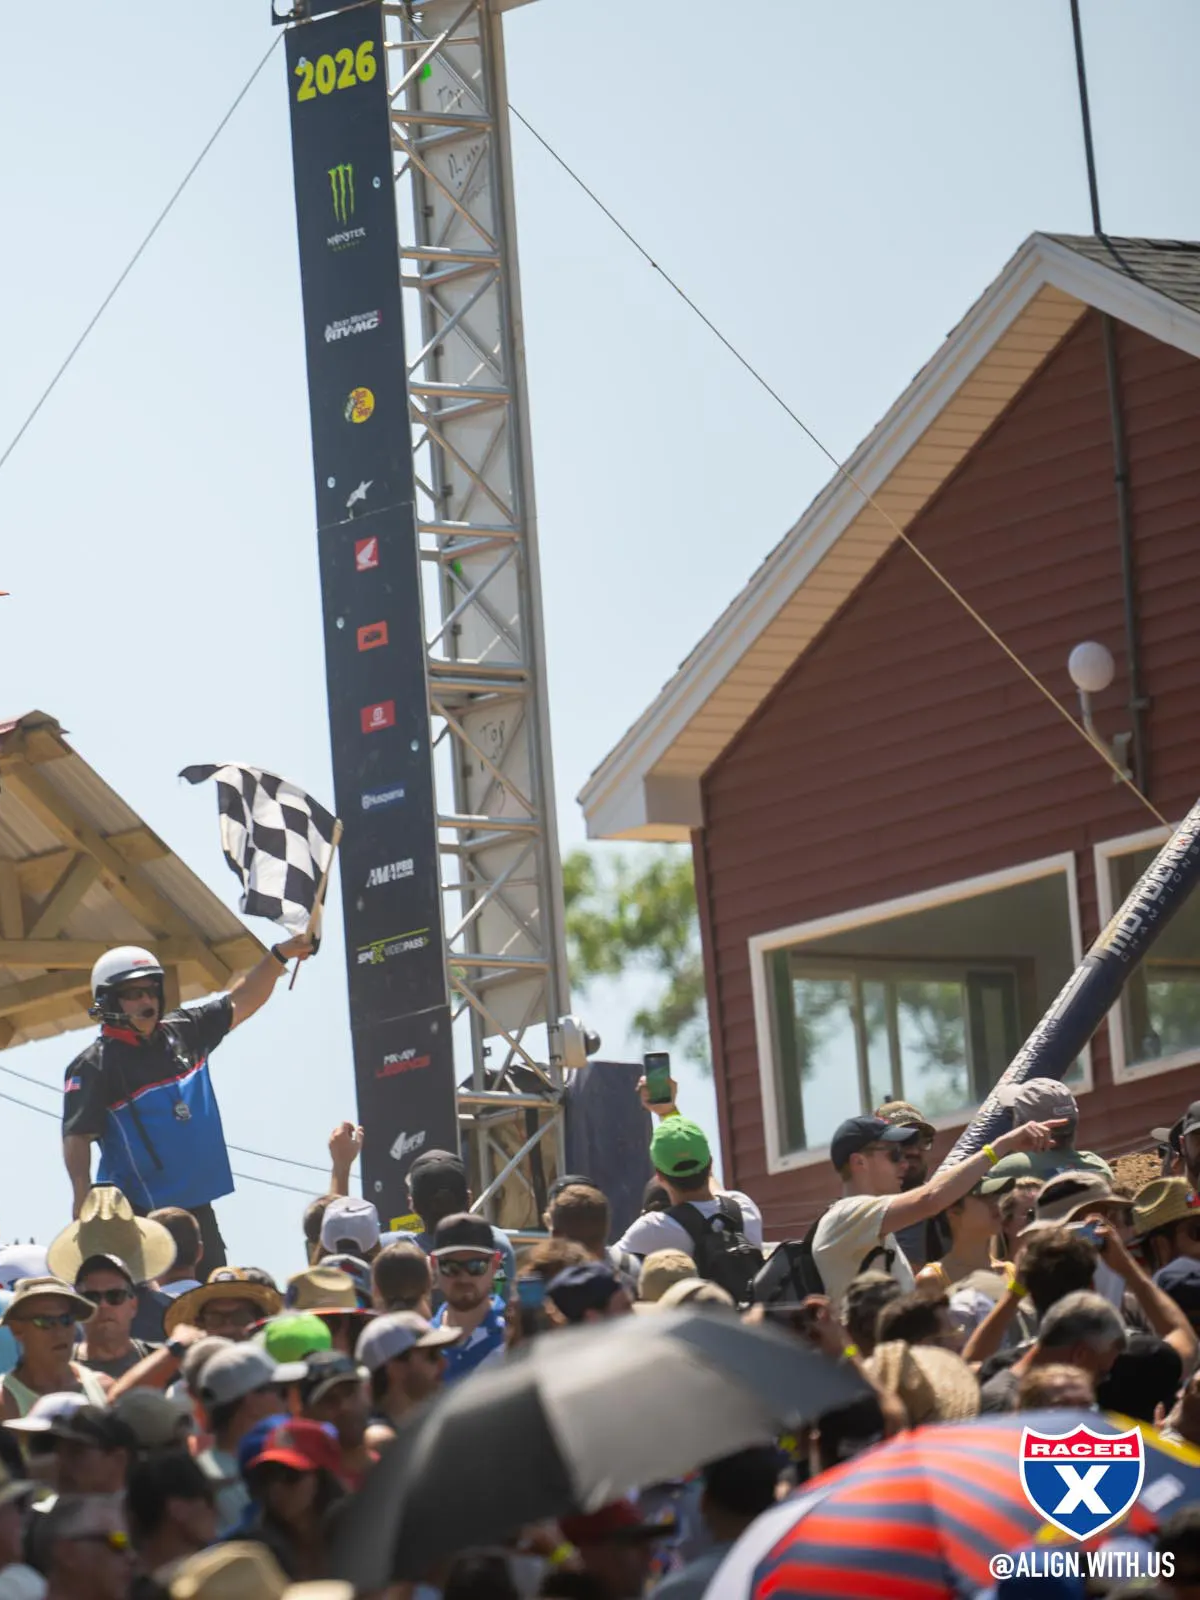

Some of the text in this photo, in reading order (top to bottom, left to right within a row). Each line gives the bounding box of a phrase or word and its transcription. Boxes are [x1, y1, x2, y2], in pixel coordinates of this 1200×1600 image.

[295, 41, 376, 101] 2026
[327, 227, 366, 246] MONSTER
[366, 863, 397, 888] AMA
